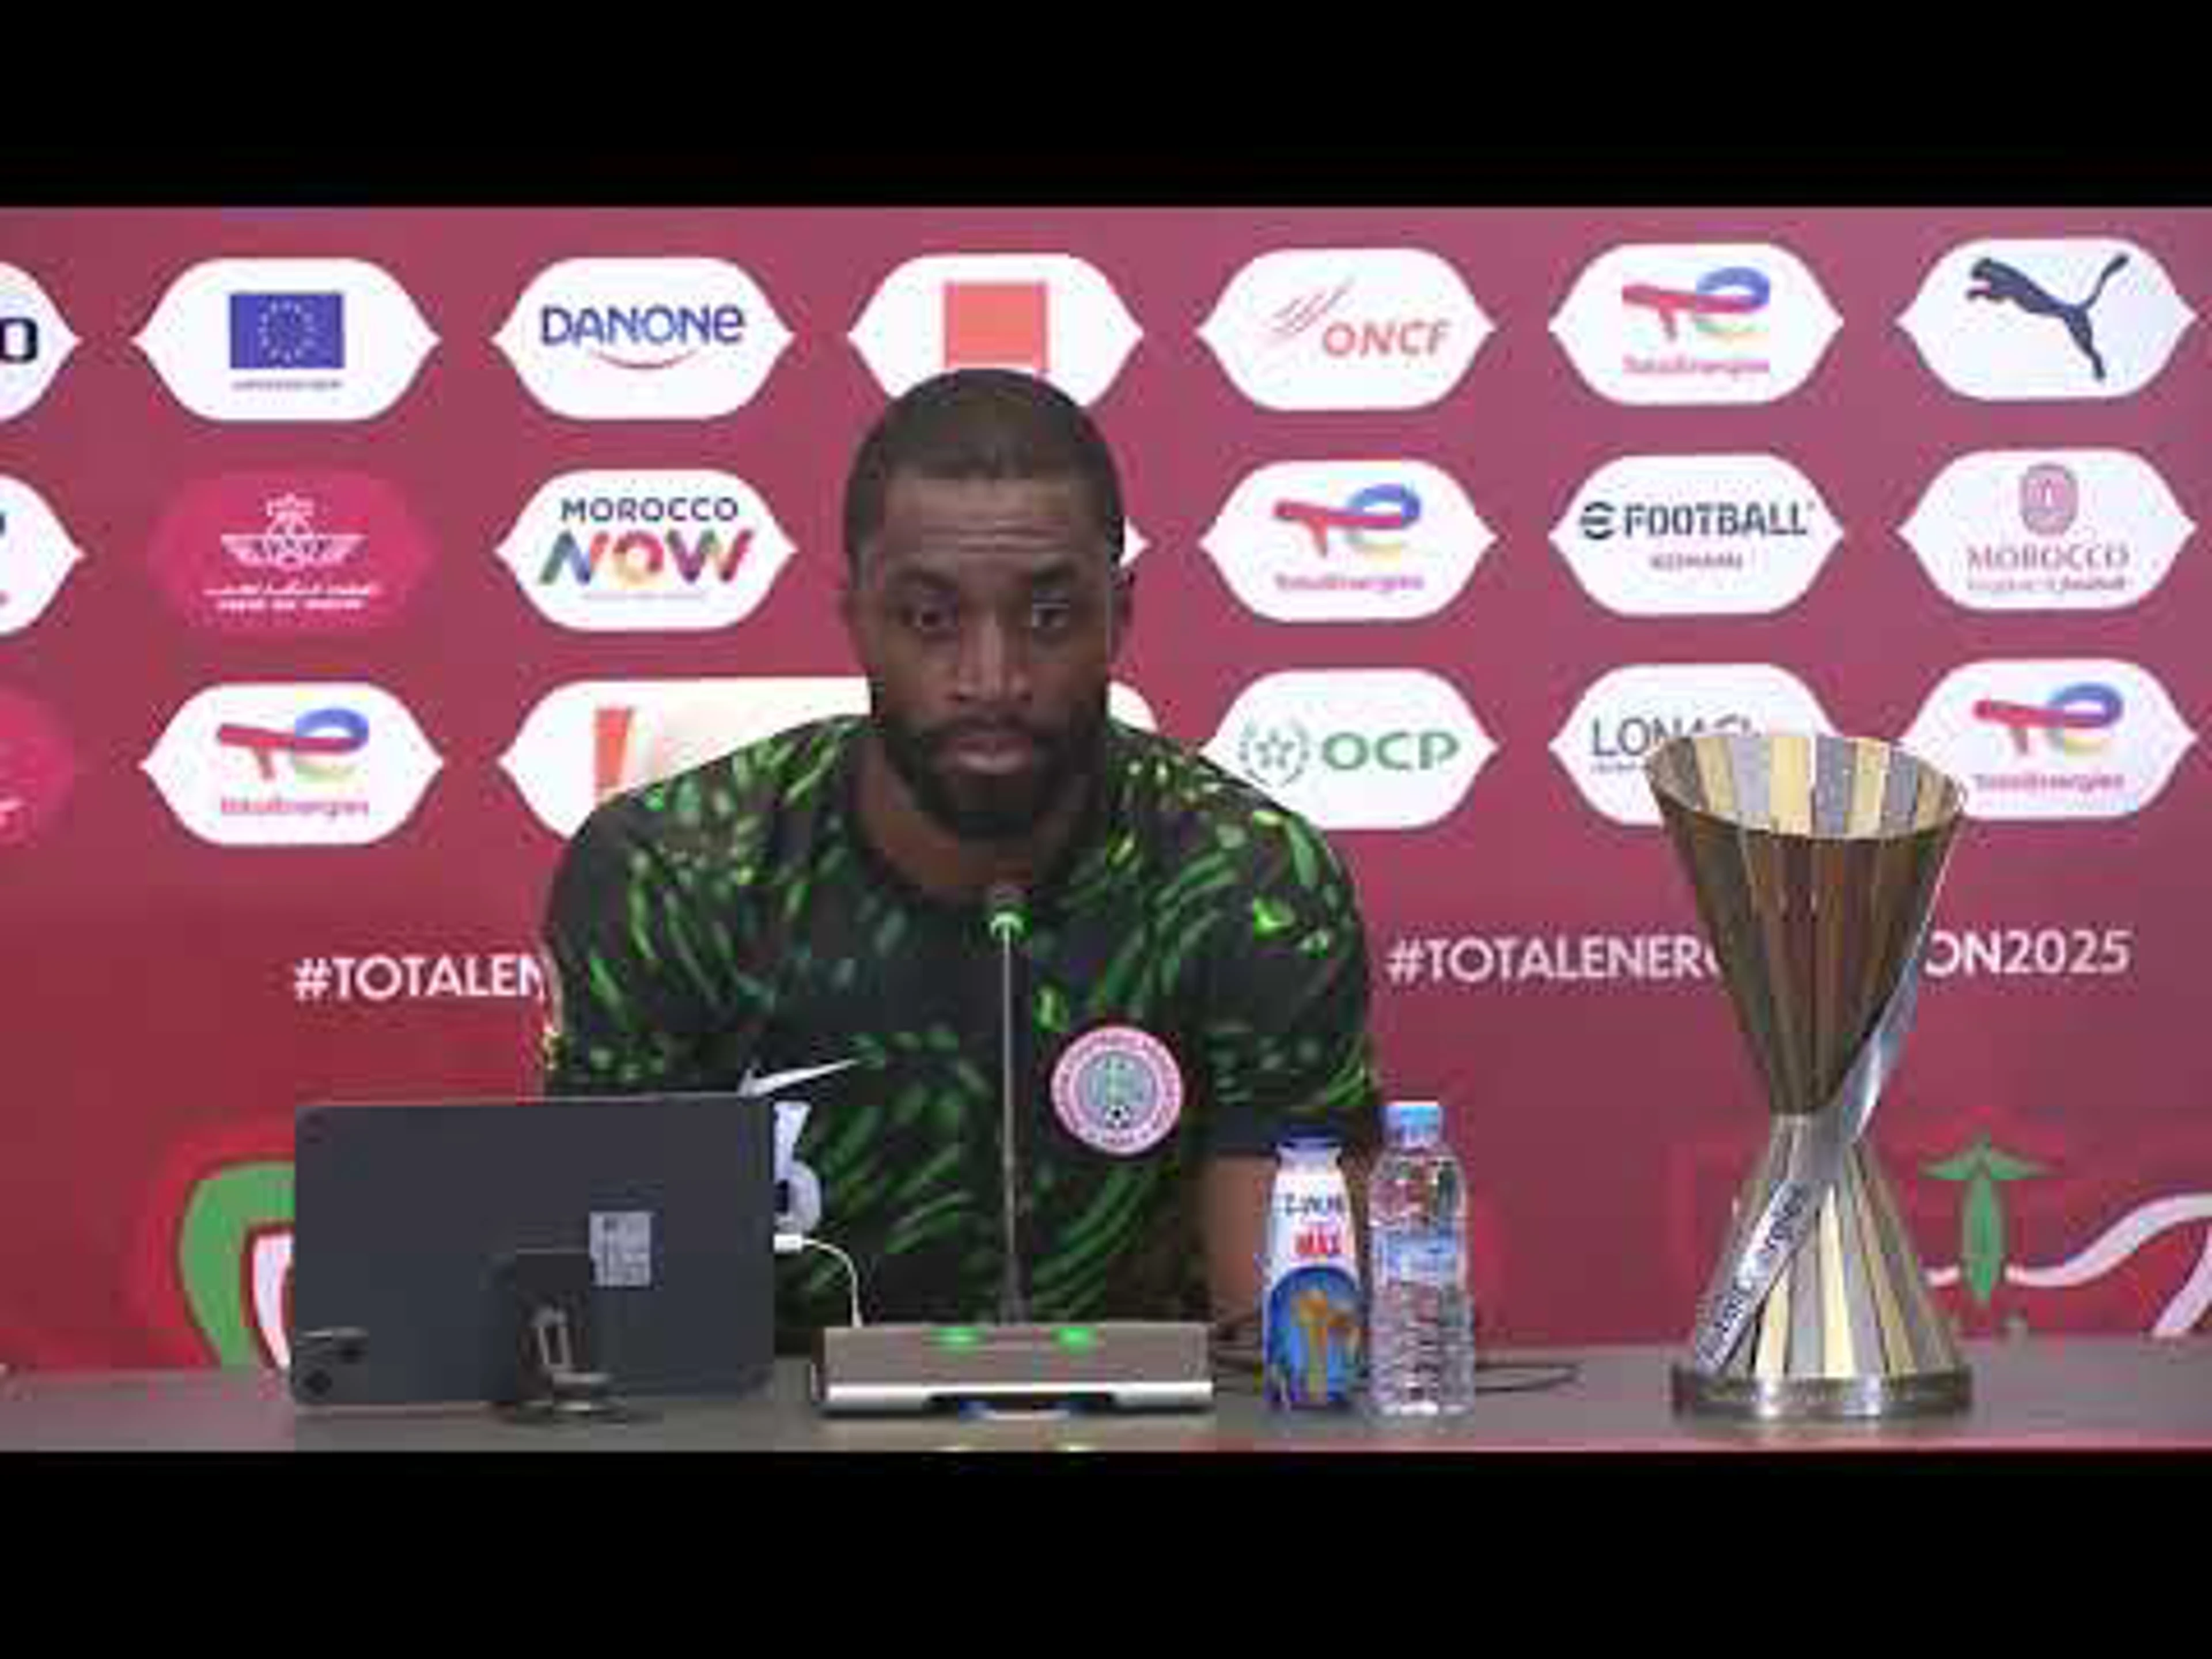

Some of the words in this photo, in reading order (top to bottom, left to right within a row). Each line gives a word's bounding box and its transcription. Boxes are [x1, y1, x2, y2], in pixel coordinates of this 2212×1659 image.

[1323, 320, 1452, 358] ONCF
[560, 496, 740, 523] MOROCCO
[537, 529, 753, 590] NOW
[1967, 543, 2130, 573] MOROCCO
[1323, 730, 1460, 771] OCP
